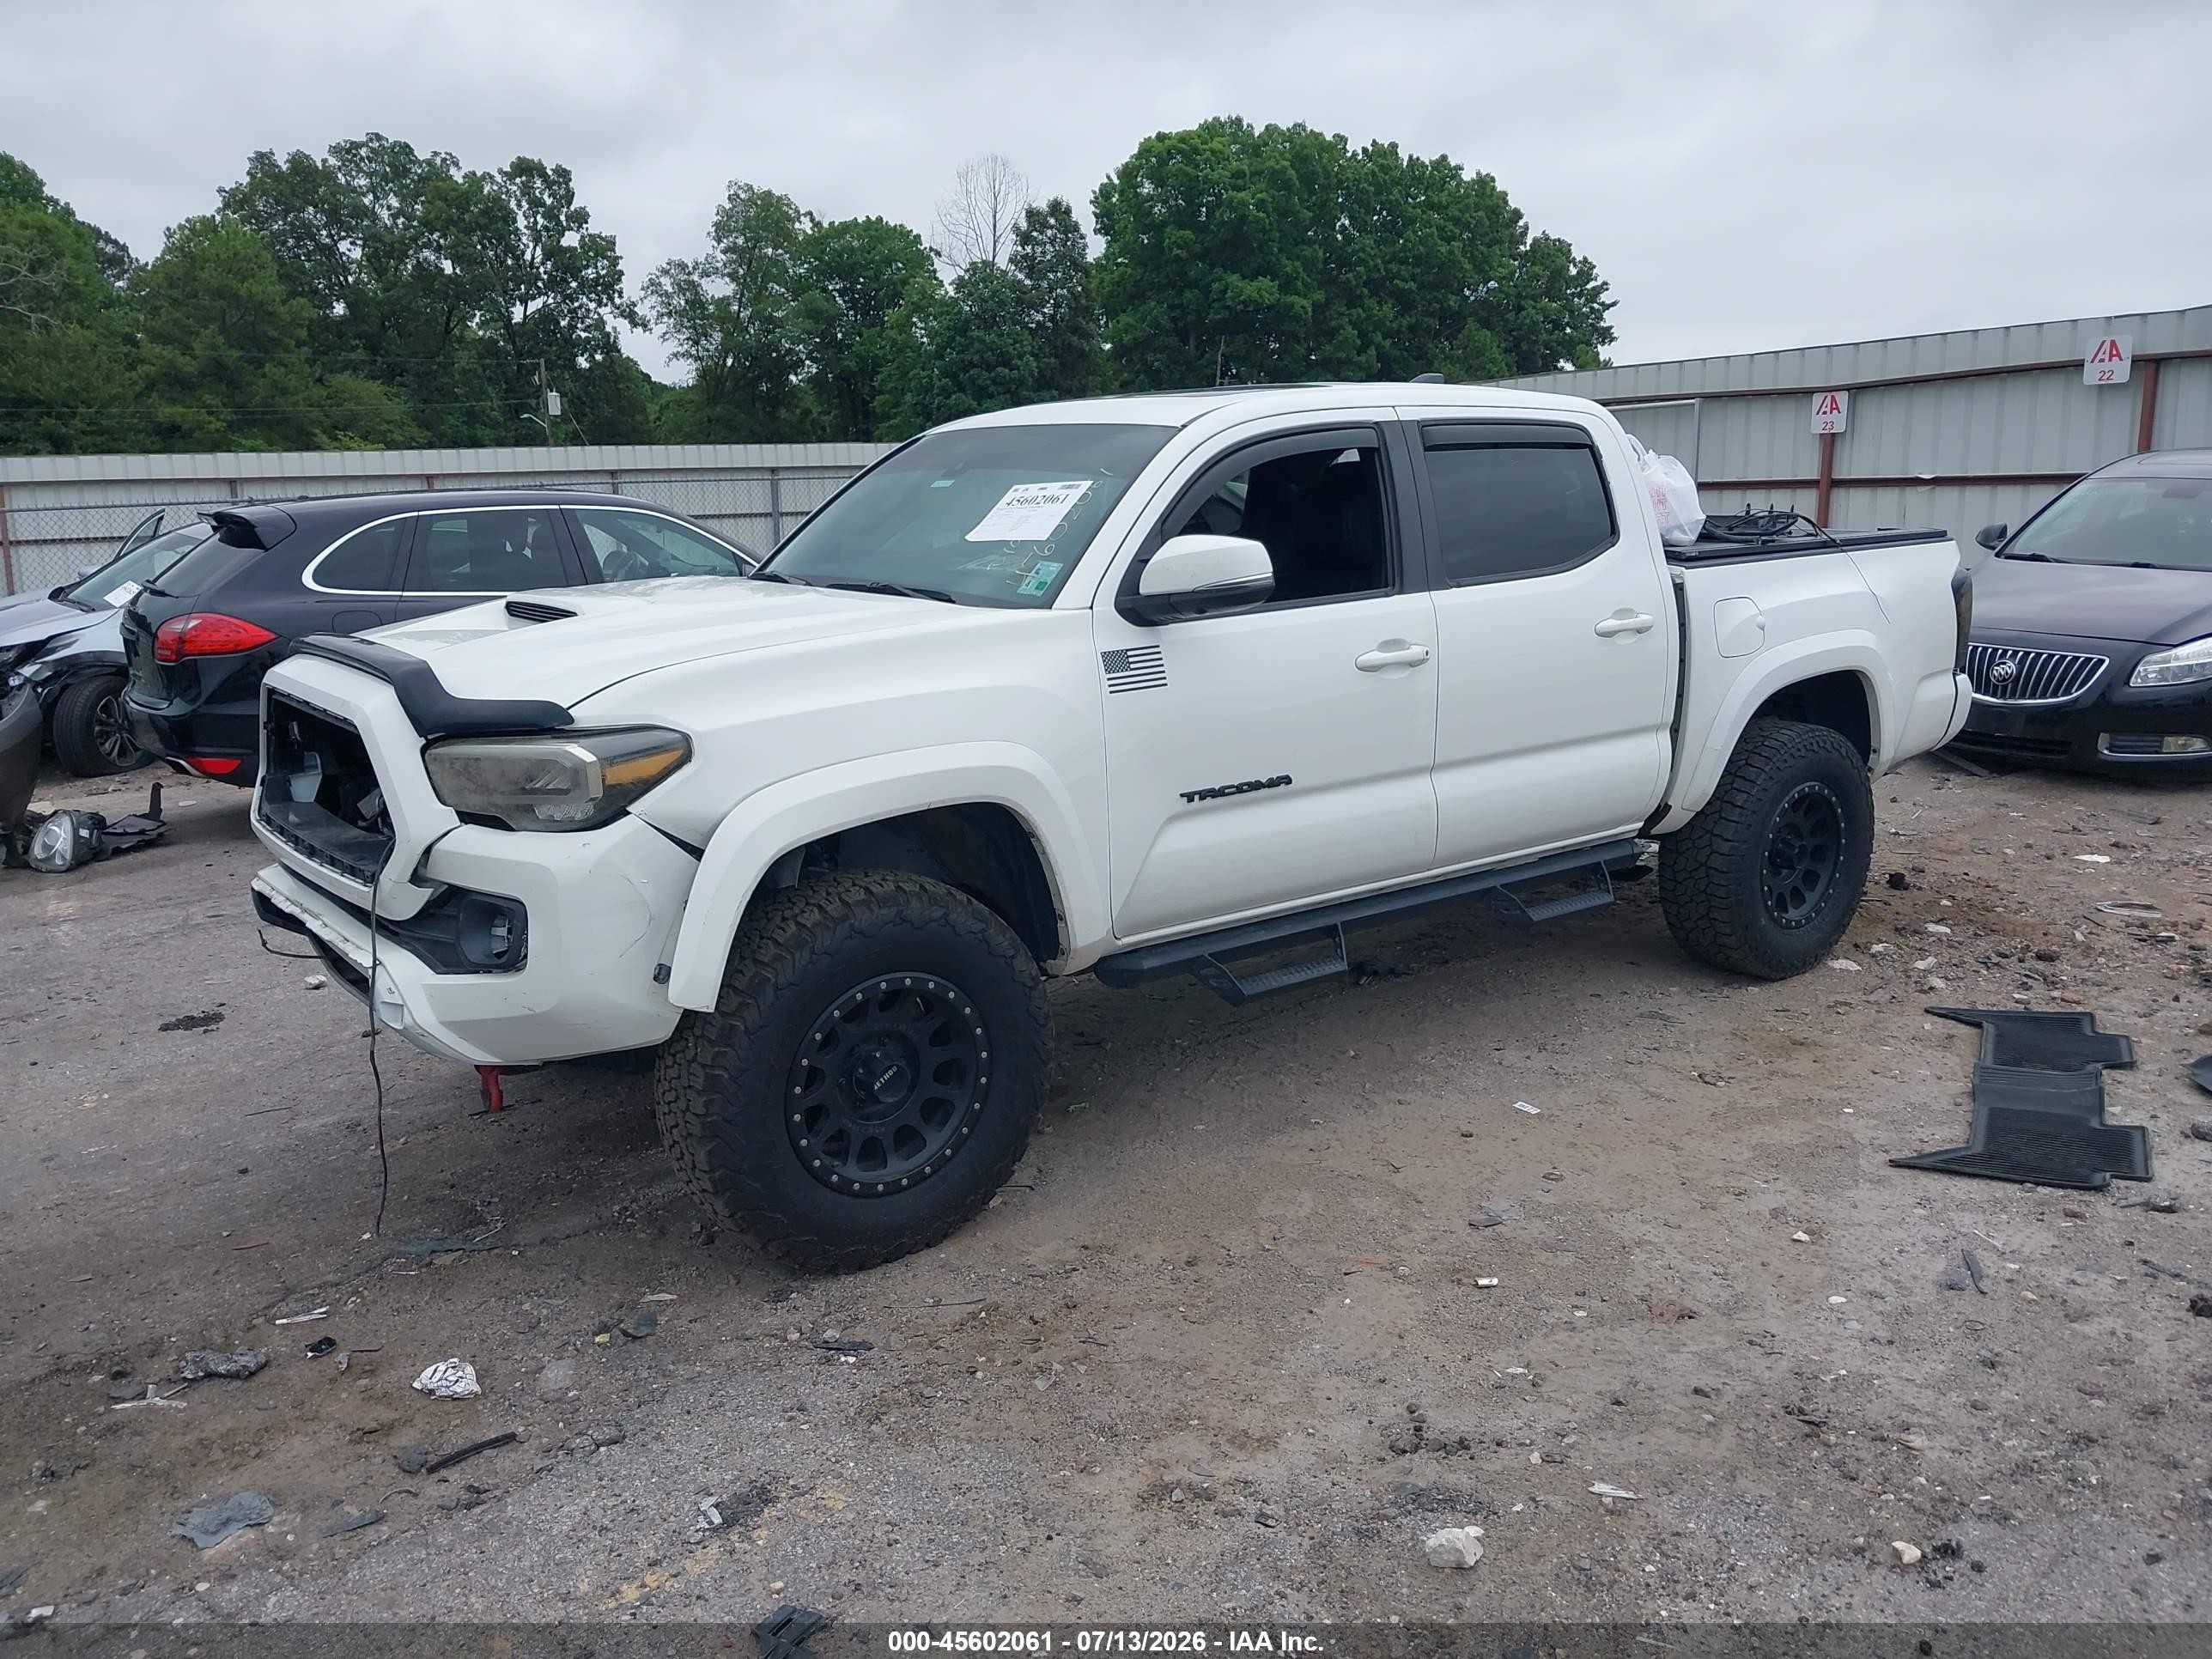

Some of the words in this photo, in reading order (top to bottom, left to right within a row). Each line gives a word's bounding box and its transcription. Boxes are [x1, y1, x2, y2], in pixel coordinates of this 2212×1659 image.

[2098, 369, 2114, 381] 22
[1821, 420, 1835, 431] 23
[1005, 493, 1071, 507] 45602061
[1179, 774, 1293, 804] TACOMA
